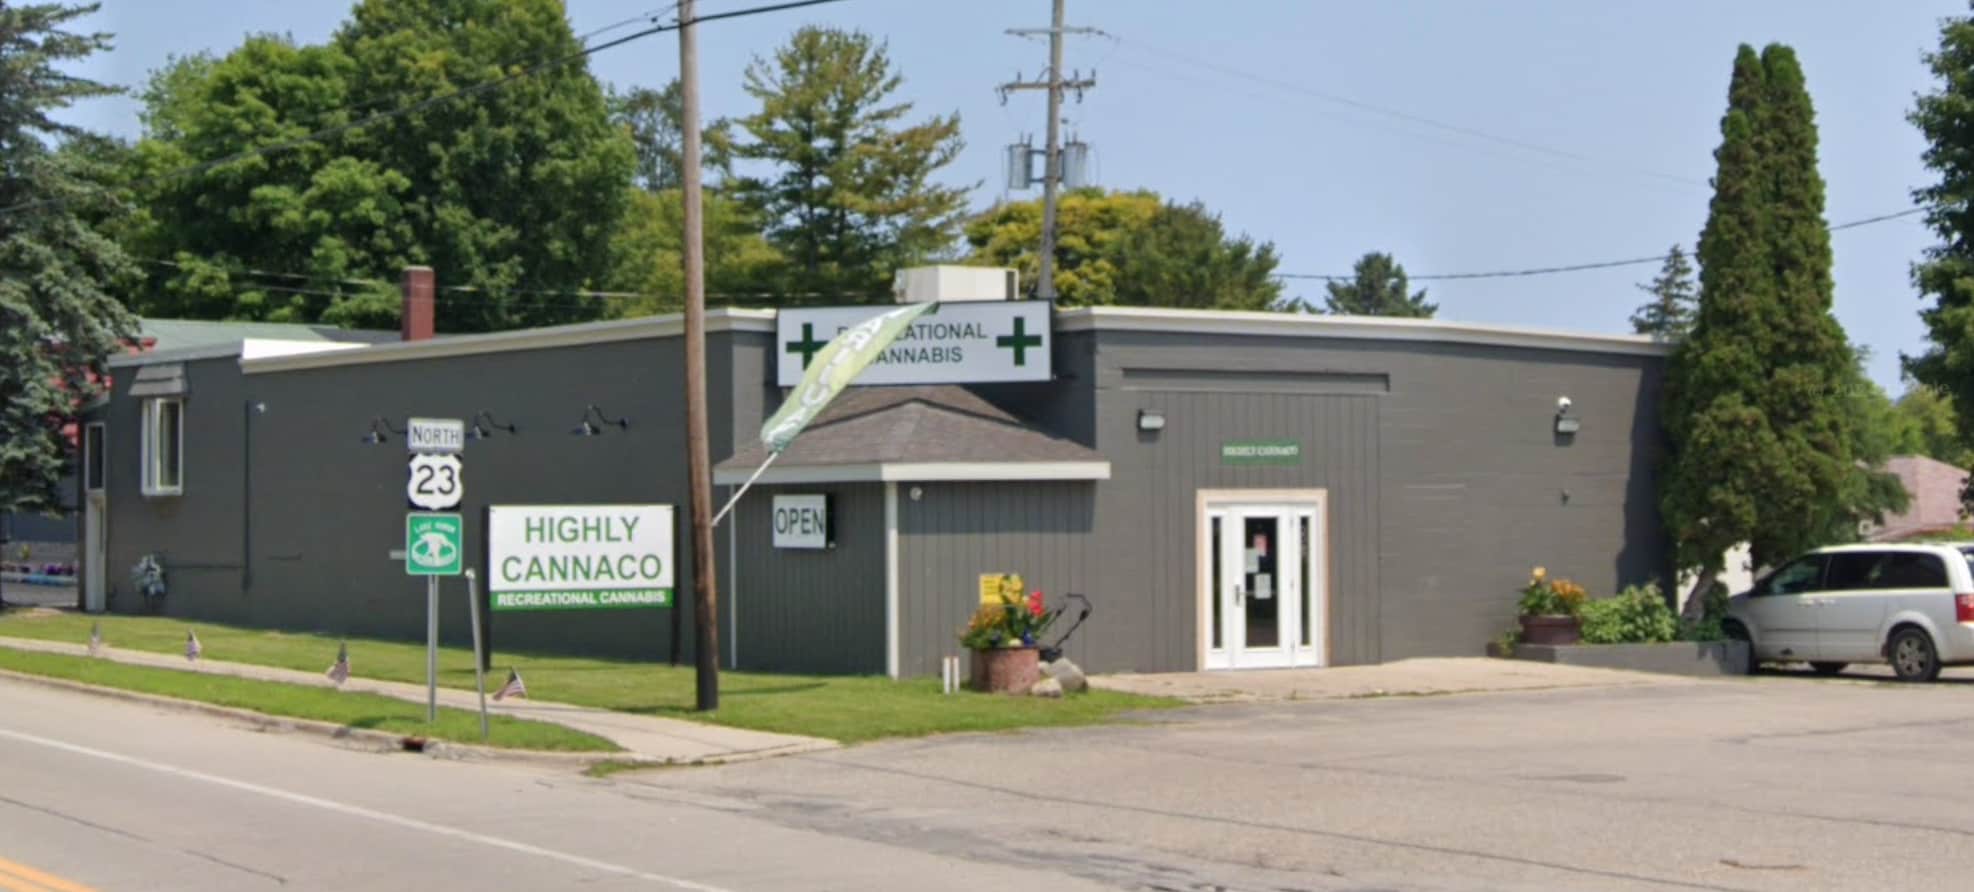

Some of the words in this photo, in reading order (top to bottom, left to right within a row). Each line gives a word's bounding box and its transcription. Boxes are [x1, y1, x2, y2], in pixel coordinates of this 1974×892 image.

[838, 323, 987, 342] ATIONAL
[871, 347, 962, 364] ANNABIS
[413, 426, 460, 443] NORTH
[416, 464, 456, 495] 23
[525, 516, 640, 543] HIGHLY
[775, 507, 824, 535] OPEN
[502, 554, 662, 582] CANNACO
[497, 591, 597, 606] RECREATIONAL
[600, 589, 666, 604] CANNABIS
